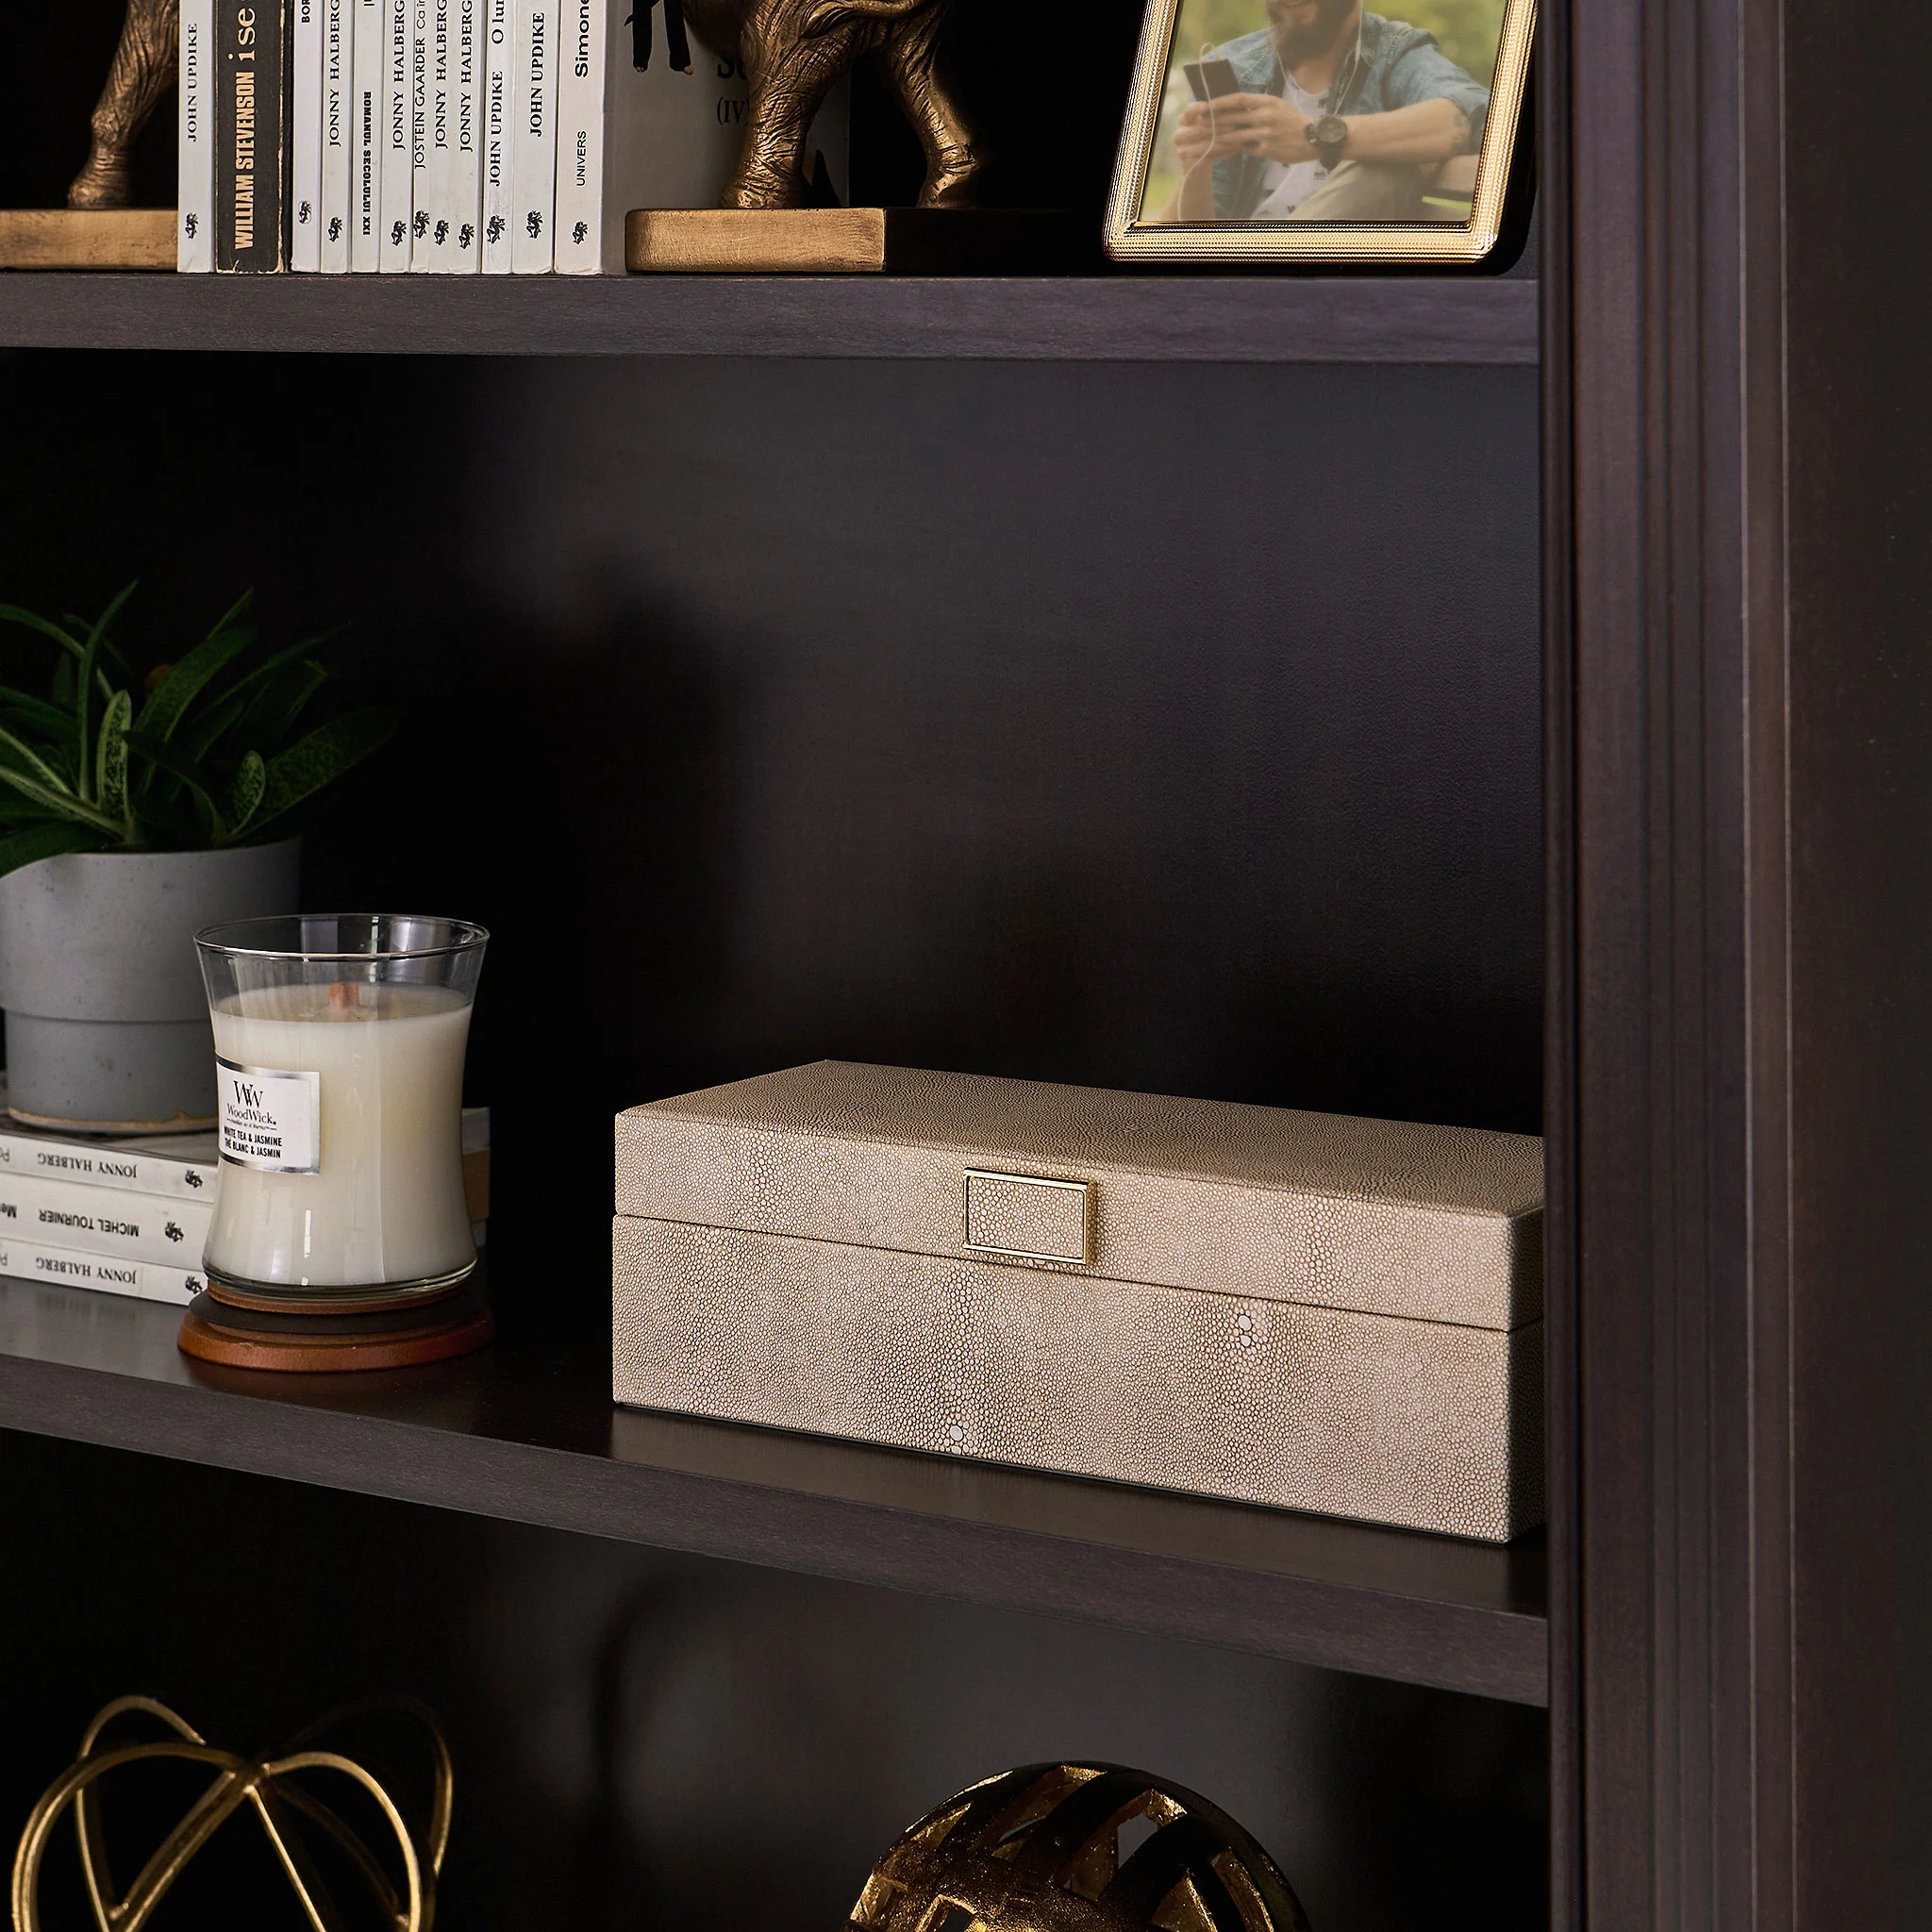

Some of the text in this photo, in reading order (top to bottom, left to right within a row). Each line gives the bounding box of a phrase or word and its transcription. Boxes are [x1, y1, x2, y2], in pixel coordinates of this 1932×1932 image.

[416, 10, 425, 29] Ca
[491, 29, 504, 44] O
[188, 24, 197, 142] JOHN UPDIKE
[329, 0, 341, 147] JONNY HALBERG
[392, 0, 406, 150] JONNY HALBERG
[415, 38, 425, 107] GAARDER
[435, 0, 448, 149] JONNY HALBERG
[460, 0, 473, 152] JONNY HALBERG
[530, 12, 544, 137] JOHN UPDIKE
[491, 71, 503, 135] UPDIKE
[235, 72, 255, 249] WILLIAM STEVENSON
[414, 111, 425, 169] JOSTEIN
[490, 141, 501, 187] JOHN
[576, 130, 586, 186] UNIVERS
[37, 1153, 92, 1172] HALBERG
[233, 1141, 248, 1153] BLANC
[251, 1145, 255, 1155] &
[257, 1147, 280, 1158] JASMIN
[238, 1130, 246, 1140] TEA
[249, 1133, 252, 1141] &
[255, 1134, 282, 1146] JASMINE
[97, 1161, 137, 1178] JONNY
[39, 1210, 94, 1230] TOURNIER
[98, 1219, 139, 1237] MICHEL
[35, 1257, 91, 1277] HALBERG
[96, 1268, 137, 1284] JONNY
